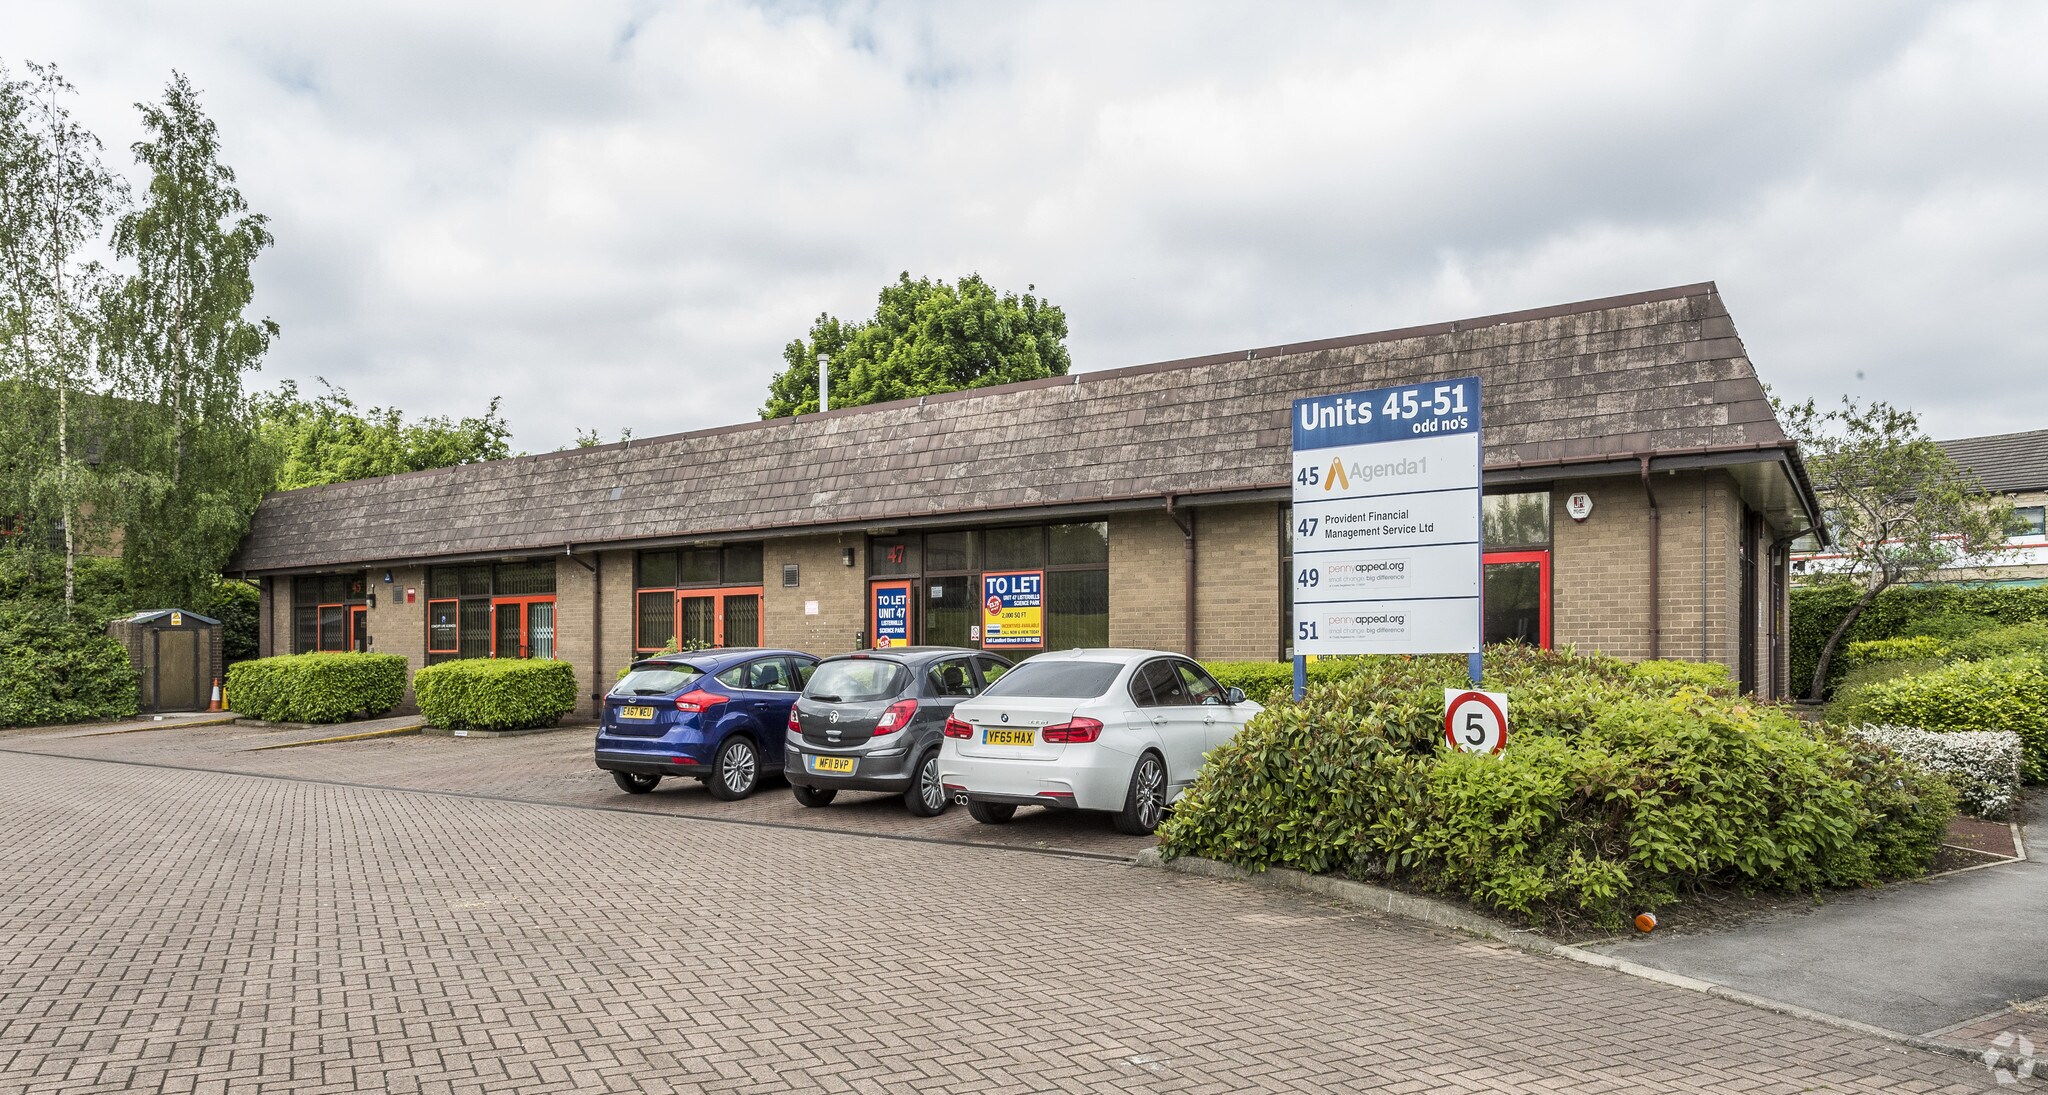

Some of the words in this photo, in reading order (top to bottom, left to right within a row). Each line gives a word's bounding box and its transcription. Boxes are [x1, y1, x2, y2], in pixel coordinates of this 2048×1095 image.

[1302, 398, 1372, 430] Units
[1382, 384, 1468, 420] 45-51
[1413, 418, 1437, 433] odd
[1442, 416, 1468, 430] no's
[1297, 466, 1319, 486] 45
[1350, 457, 1426, 482] Agenda1
[1298, 518, 1318, 537] 47
[1325, 512, 1366, 524] Provident
[1368, 510, 1409, 522] Financial
[1325, 526, 1380, 539] Management
[1383, 524, 1416, 535] Service
[1419, 523, 1434, 533] Ltd
[888, 545, 904, 563] 47
[1298, 568, 1319, 588] 49
[1329, 562, 1404, 574] pennyappeal.org
[987, 577, 1008, 594] TO
[1012, 576, 1040, 593] LET
[878, 596, 889, 605] TO
[891, 595, 906, 605] LET
[878, 608, 895, 618] UNIT
[896, 608, 905, 618] 47
[1298, 621, 1318, 640] 51
[1329, 614, 1404, 625] pennyappeal.org
[639, 707, 652, 716] WEU
[989, 731, 1012, 743] YF65
[1014, 731, 1033, 743] HAX
[1465, 714, 1486, 746] 5
[819, 758, 833, 768] MF11
[834, 759, 849, 769] BVP
